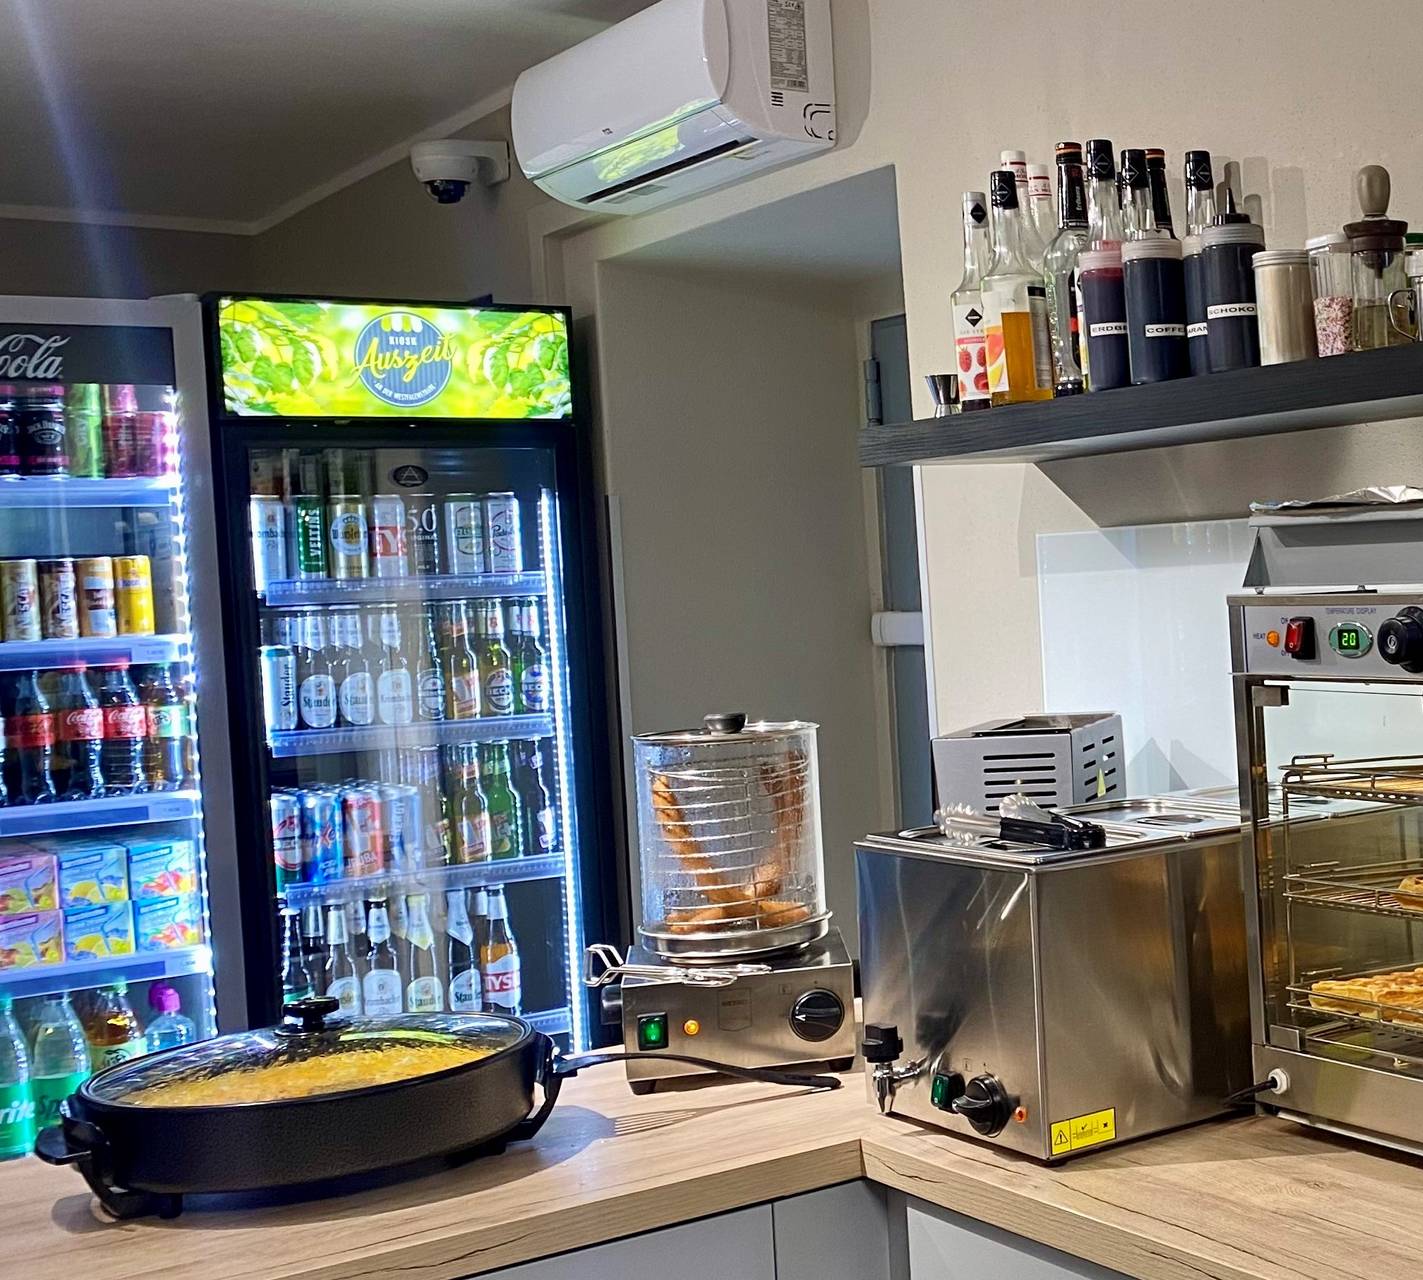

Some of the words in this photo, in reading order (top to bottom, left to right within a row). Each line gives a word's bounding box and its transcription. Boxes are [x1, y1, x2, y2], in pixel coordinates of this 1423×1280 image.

[1208, 305, 1255, 315] SCHOKO
[389, 336, 417, 346] KIOSK
[344, 333, 457, 383] Auszeit
[309, 508, 321, 557] VELTINS
[1253, 632, 1266, 640] HEAT
[1341, 632, 1356, 646] 20
[280, 663, 292, 707] Stauder
